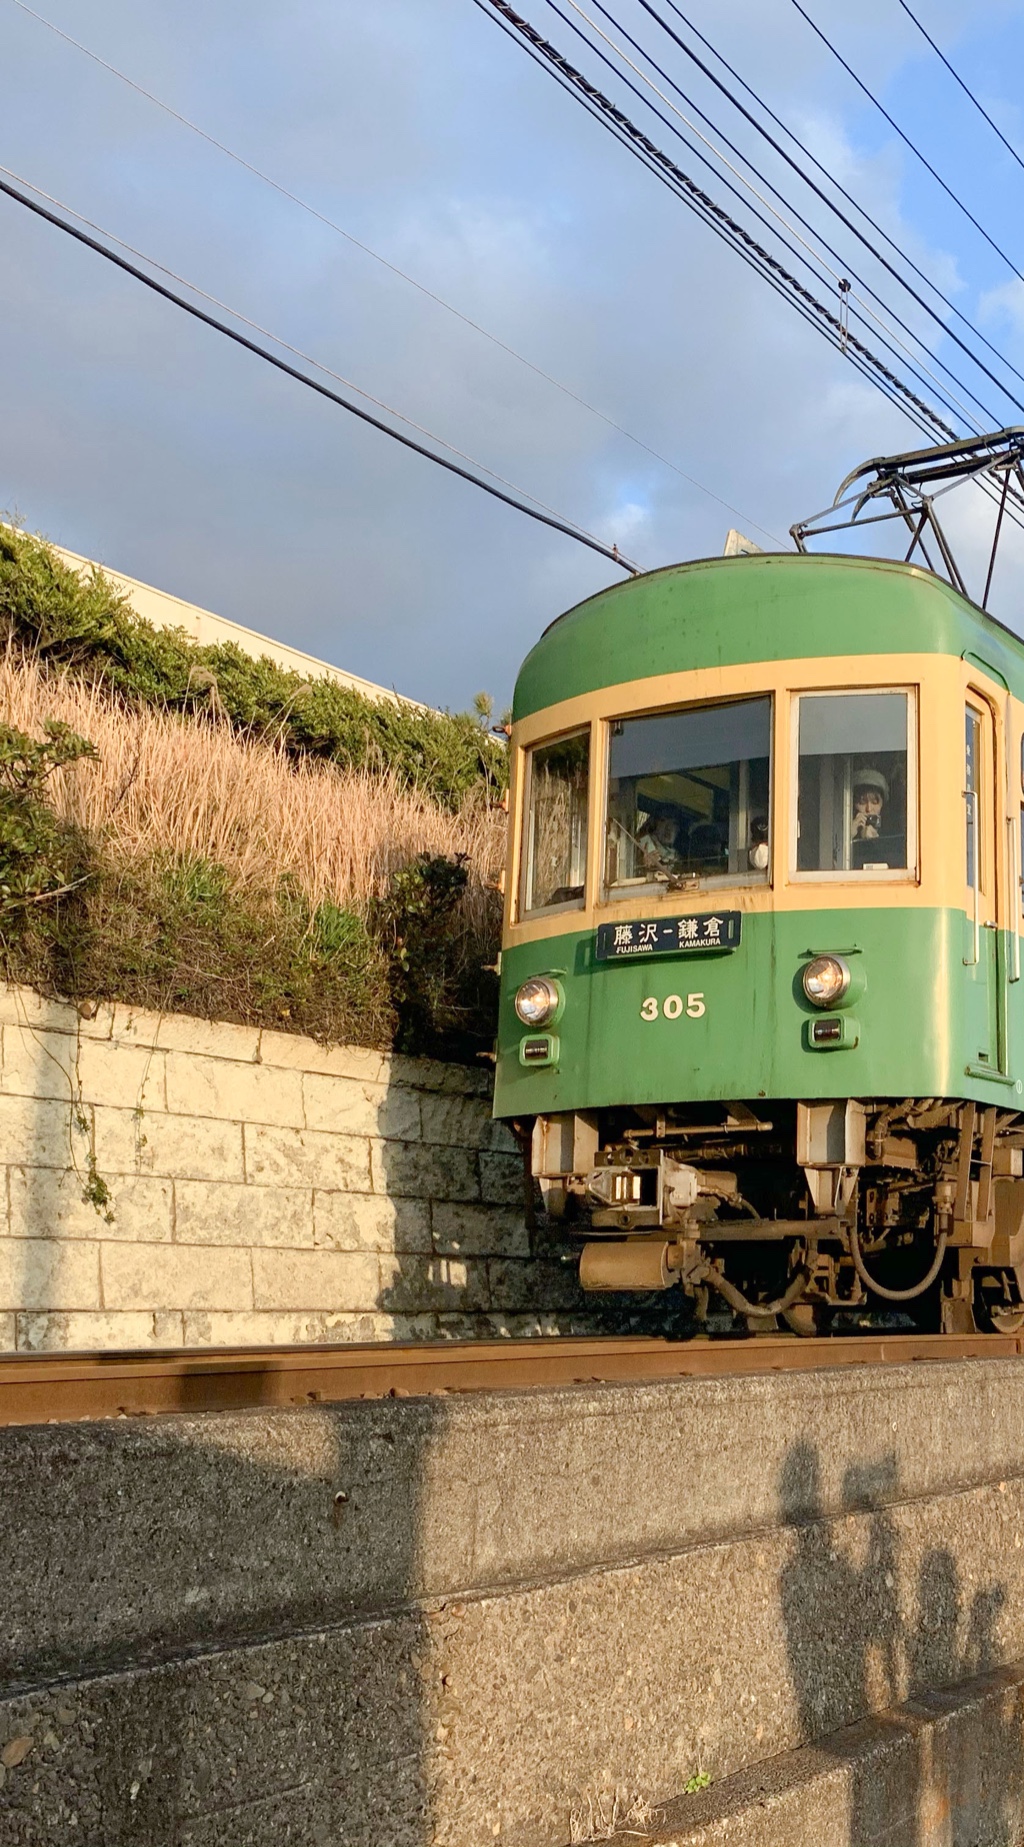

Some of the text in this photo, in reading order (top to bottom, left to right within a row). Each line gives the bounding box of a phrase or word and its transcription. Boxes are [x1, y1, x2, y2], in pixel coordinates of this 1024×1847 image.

[616, 937, 721, 954] FUJISAWA KAMAKURA
[640, 992, 706, 1021] 305
